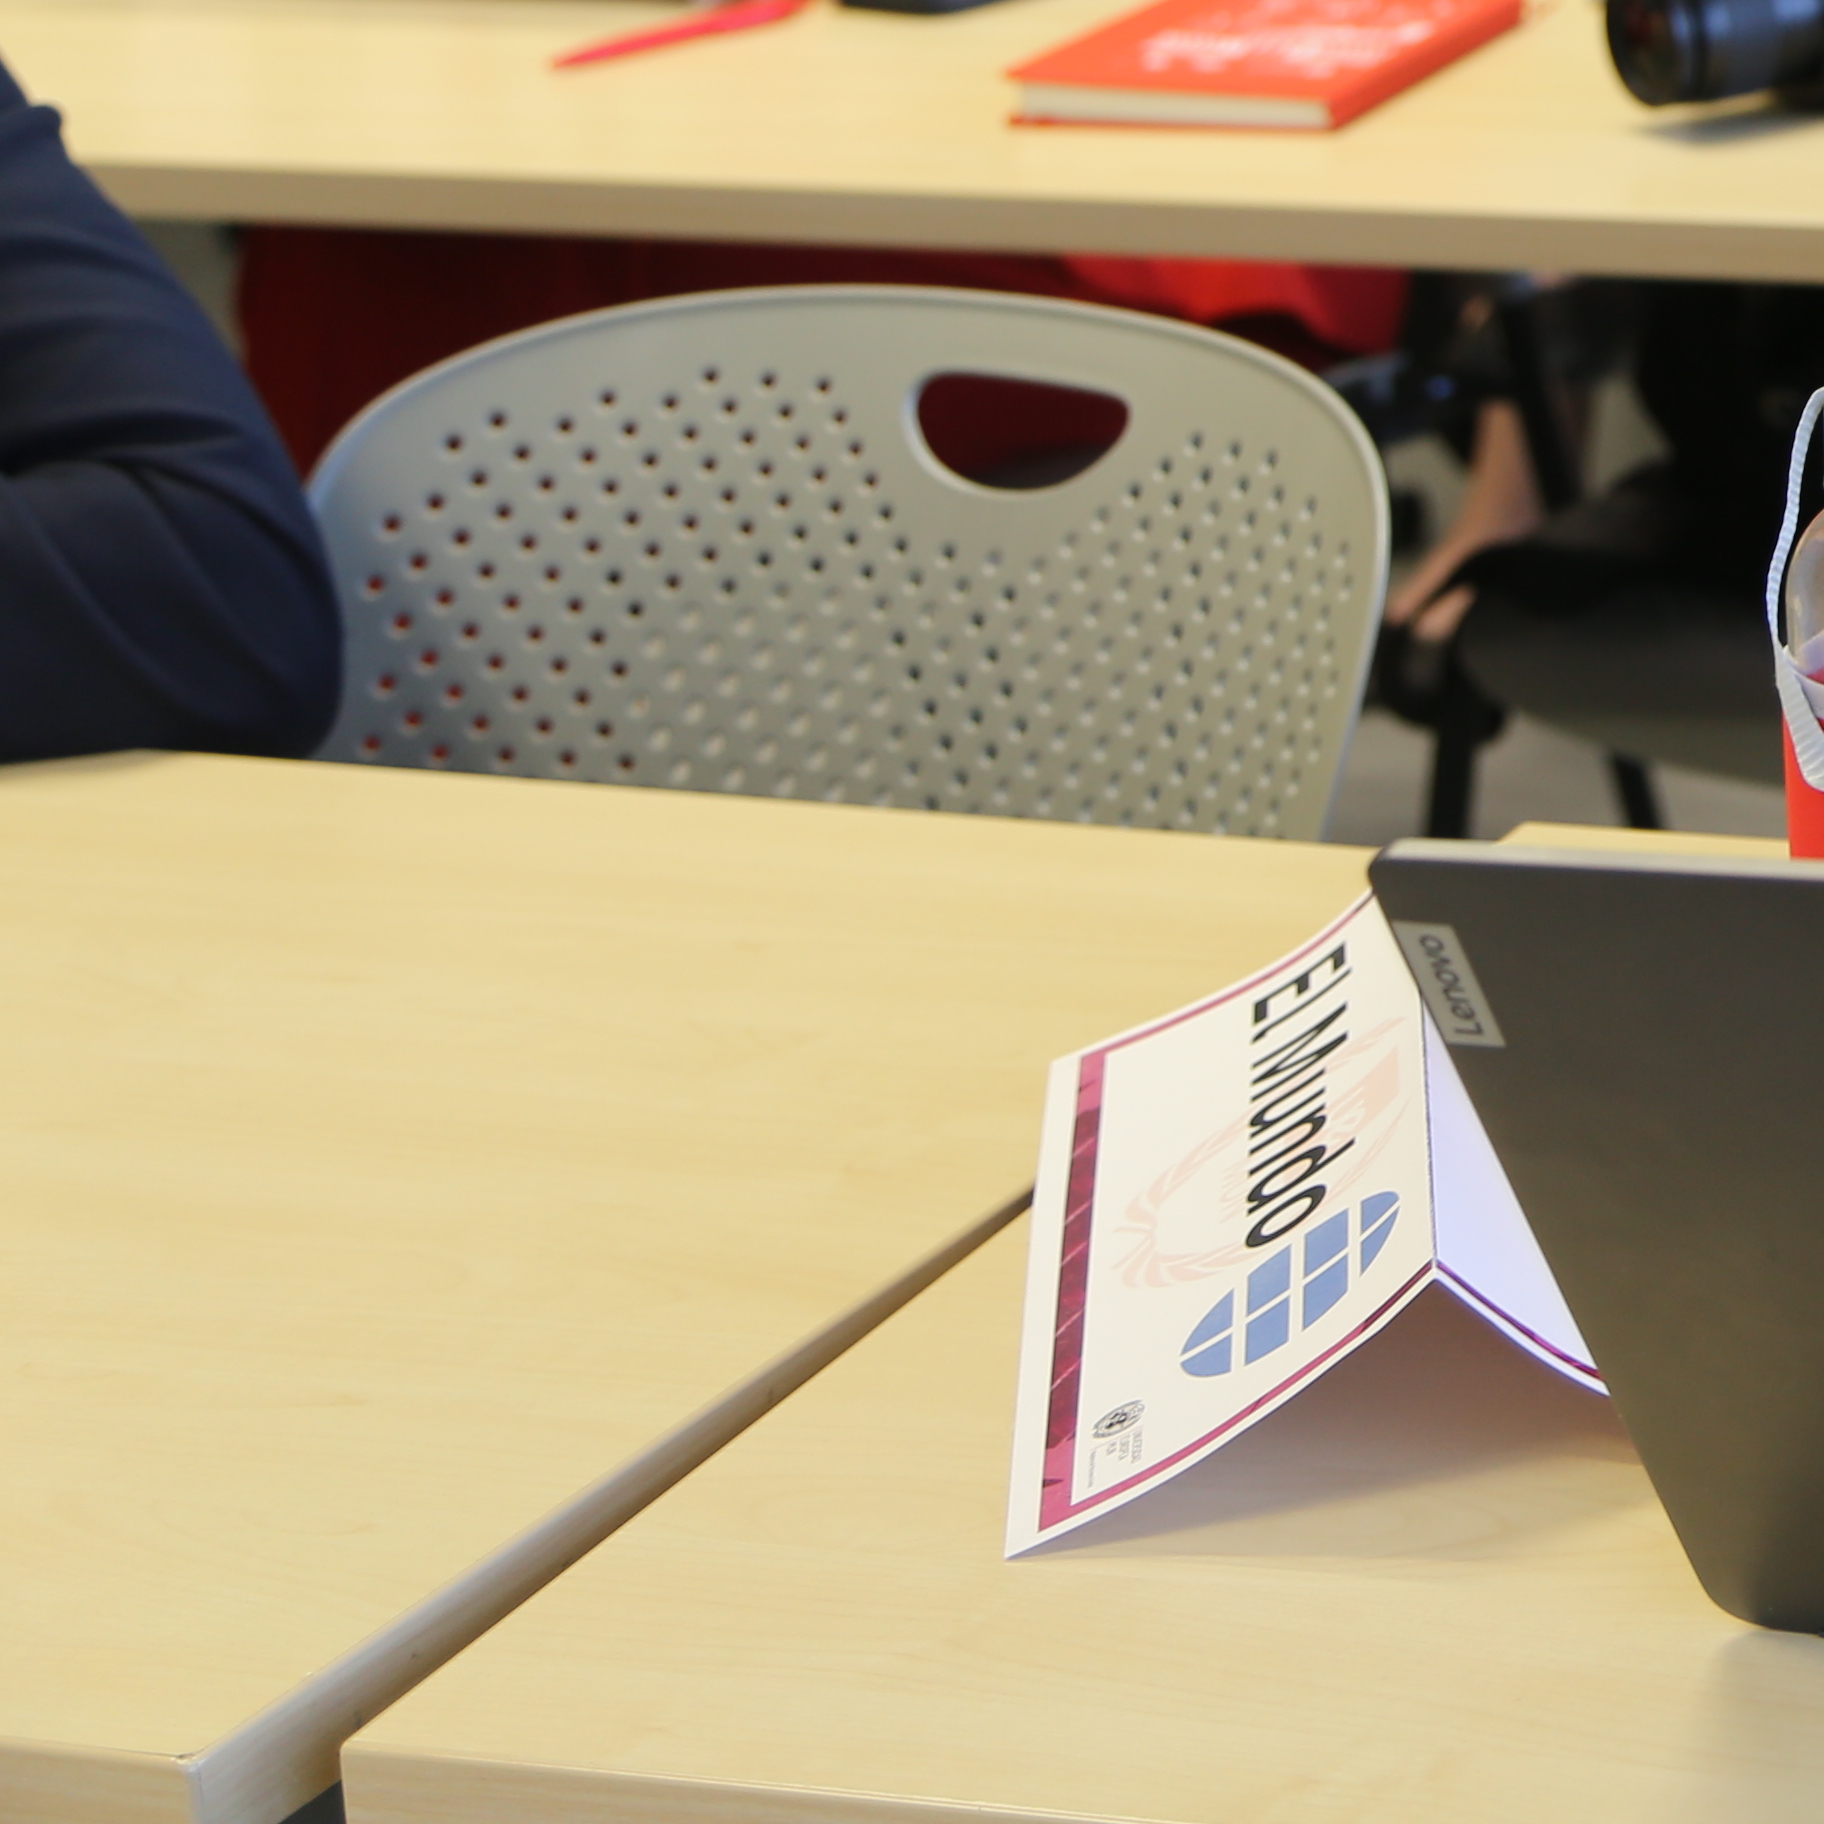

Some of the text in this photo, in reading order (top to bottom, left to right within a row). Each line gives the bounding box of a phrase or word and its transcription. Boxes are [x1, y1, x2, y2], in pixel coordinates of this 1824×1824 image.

[1419, 934, 1485, 1036] Lenovo
[1246, 941, 1356, 1248] El Mundo
